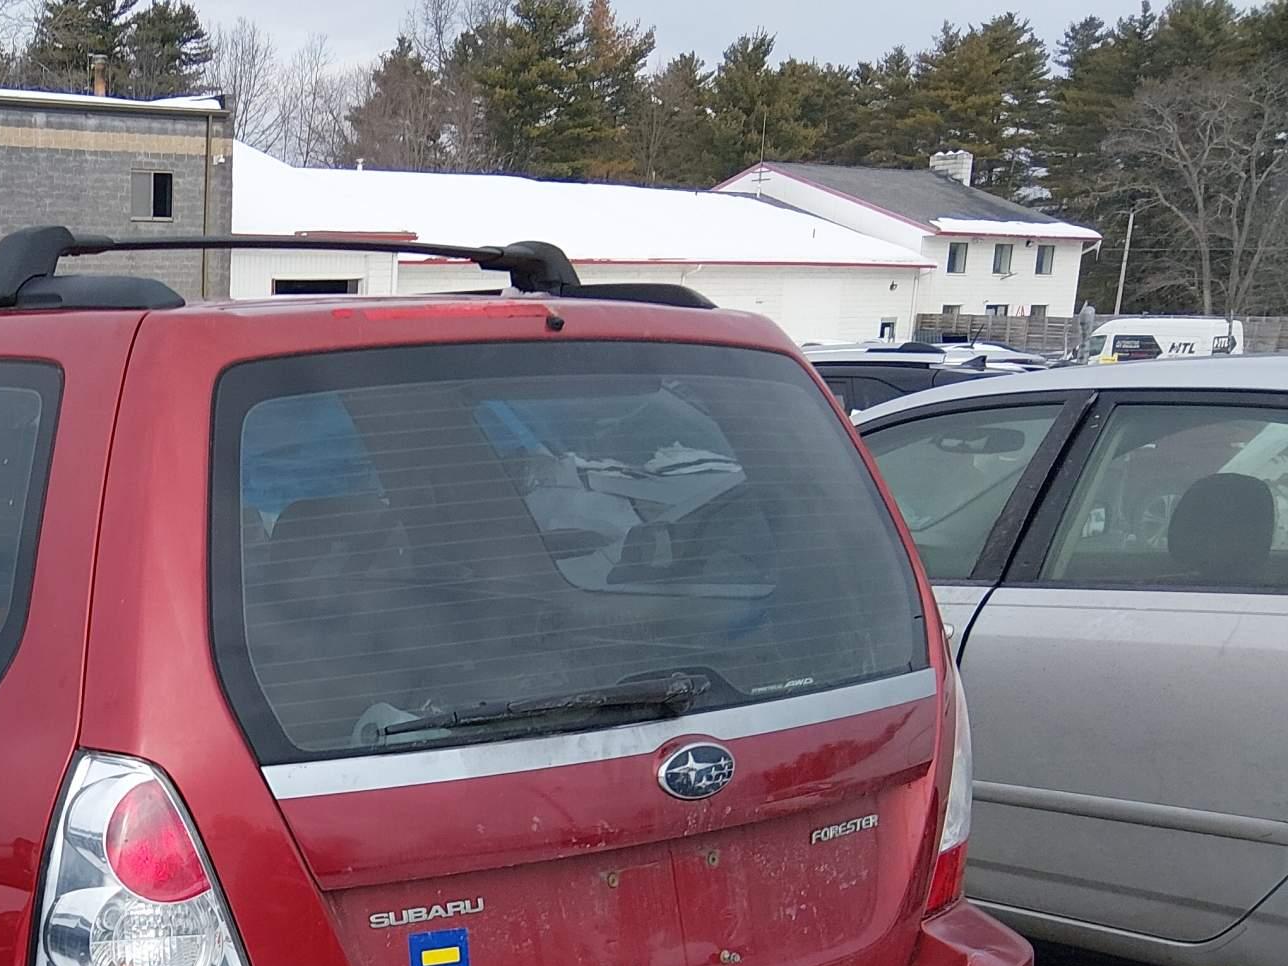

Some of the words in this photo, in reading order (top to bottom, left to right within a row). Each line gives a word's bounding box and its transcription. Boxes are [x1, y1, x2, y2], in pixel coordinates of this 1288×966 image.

[784, 677, 814, 688] AWD
[812, 814, 879, 845] FORESTER
[369, 898, 484, 929] SUBARU
